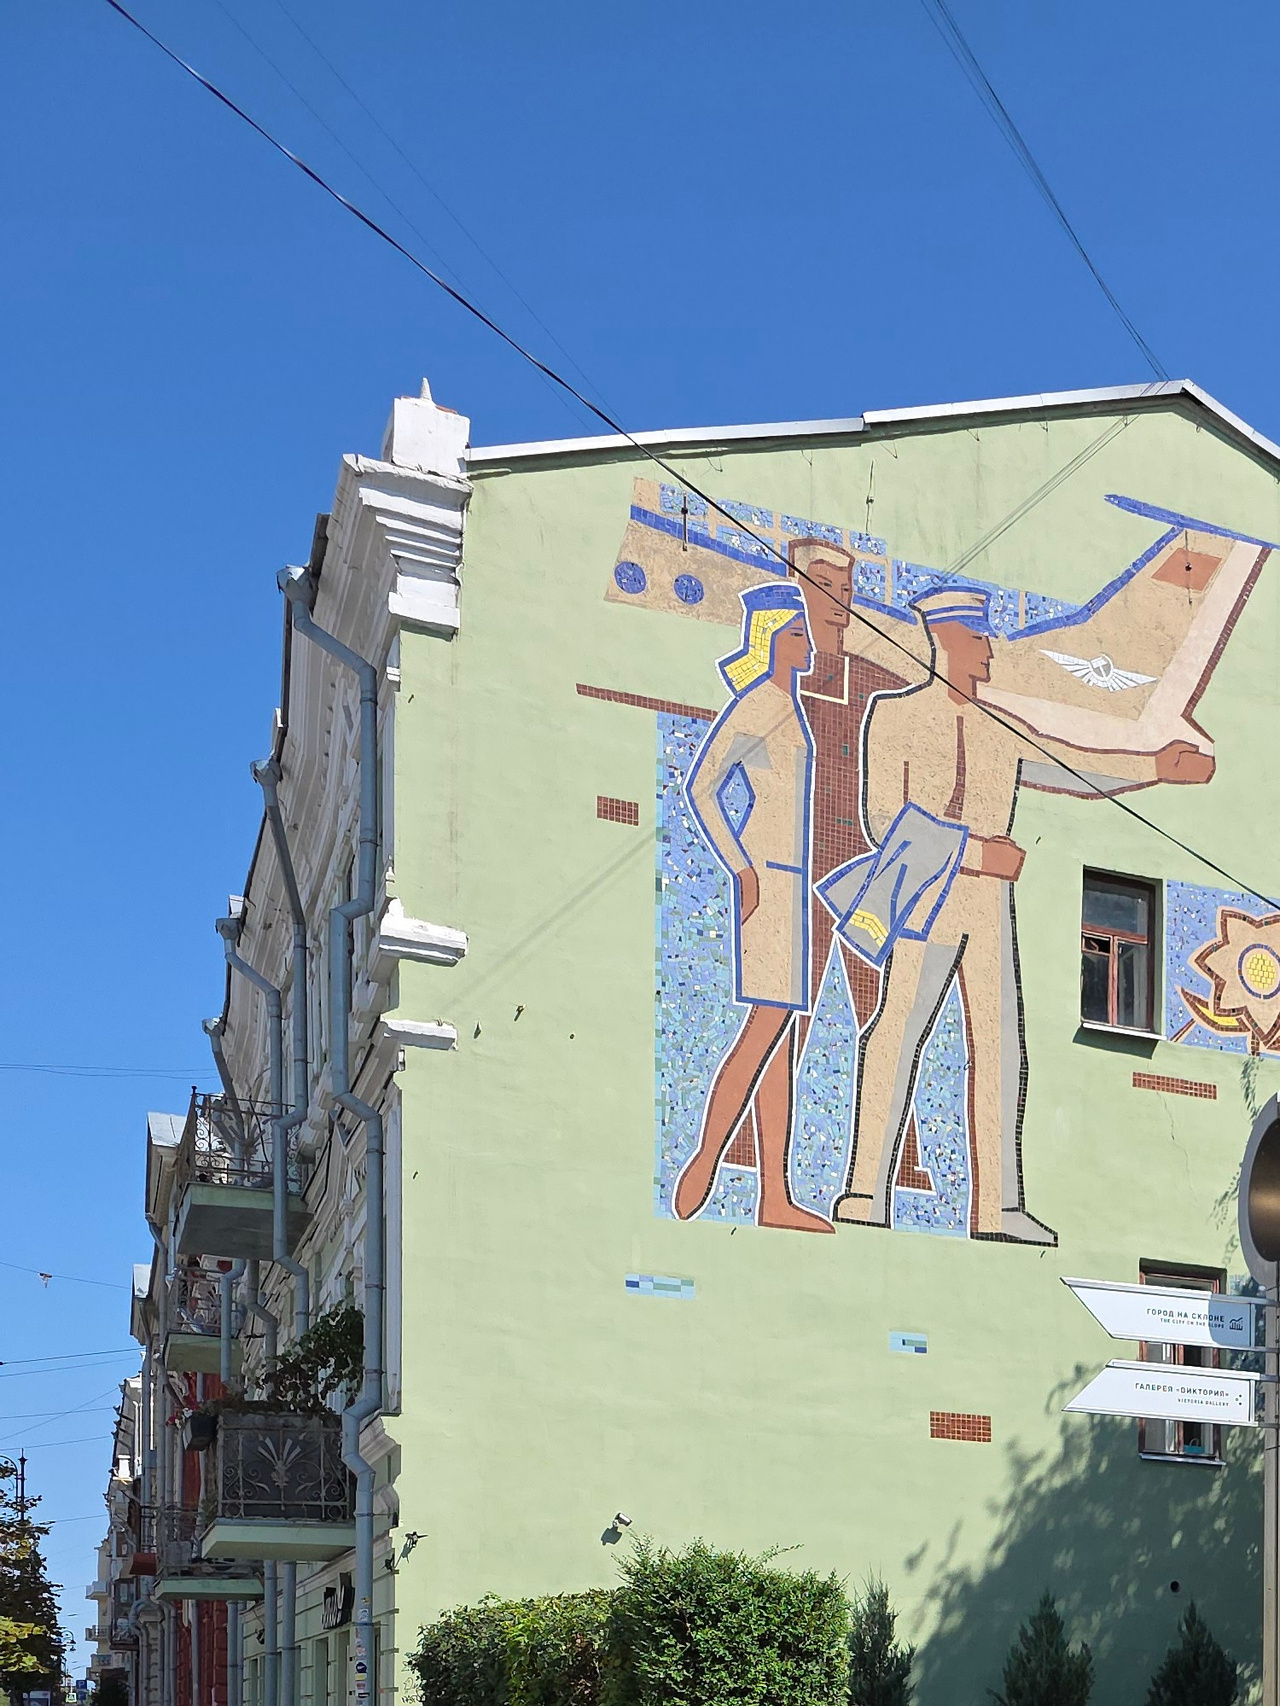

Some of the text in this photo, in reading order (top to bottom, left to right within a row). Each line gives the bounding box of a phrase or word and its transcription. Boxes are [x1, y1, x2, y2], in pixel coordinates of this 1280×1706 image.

[1147, 1308, 1174, 1318] ГОРОД
[1192, 1313, 1225, 1322] СКЛОНЕ
[1135, 1382, 1229, 1397] ГАЛЕРЕЯ «ВИКТОРИЯ»
